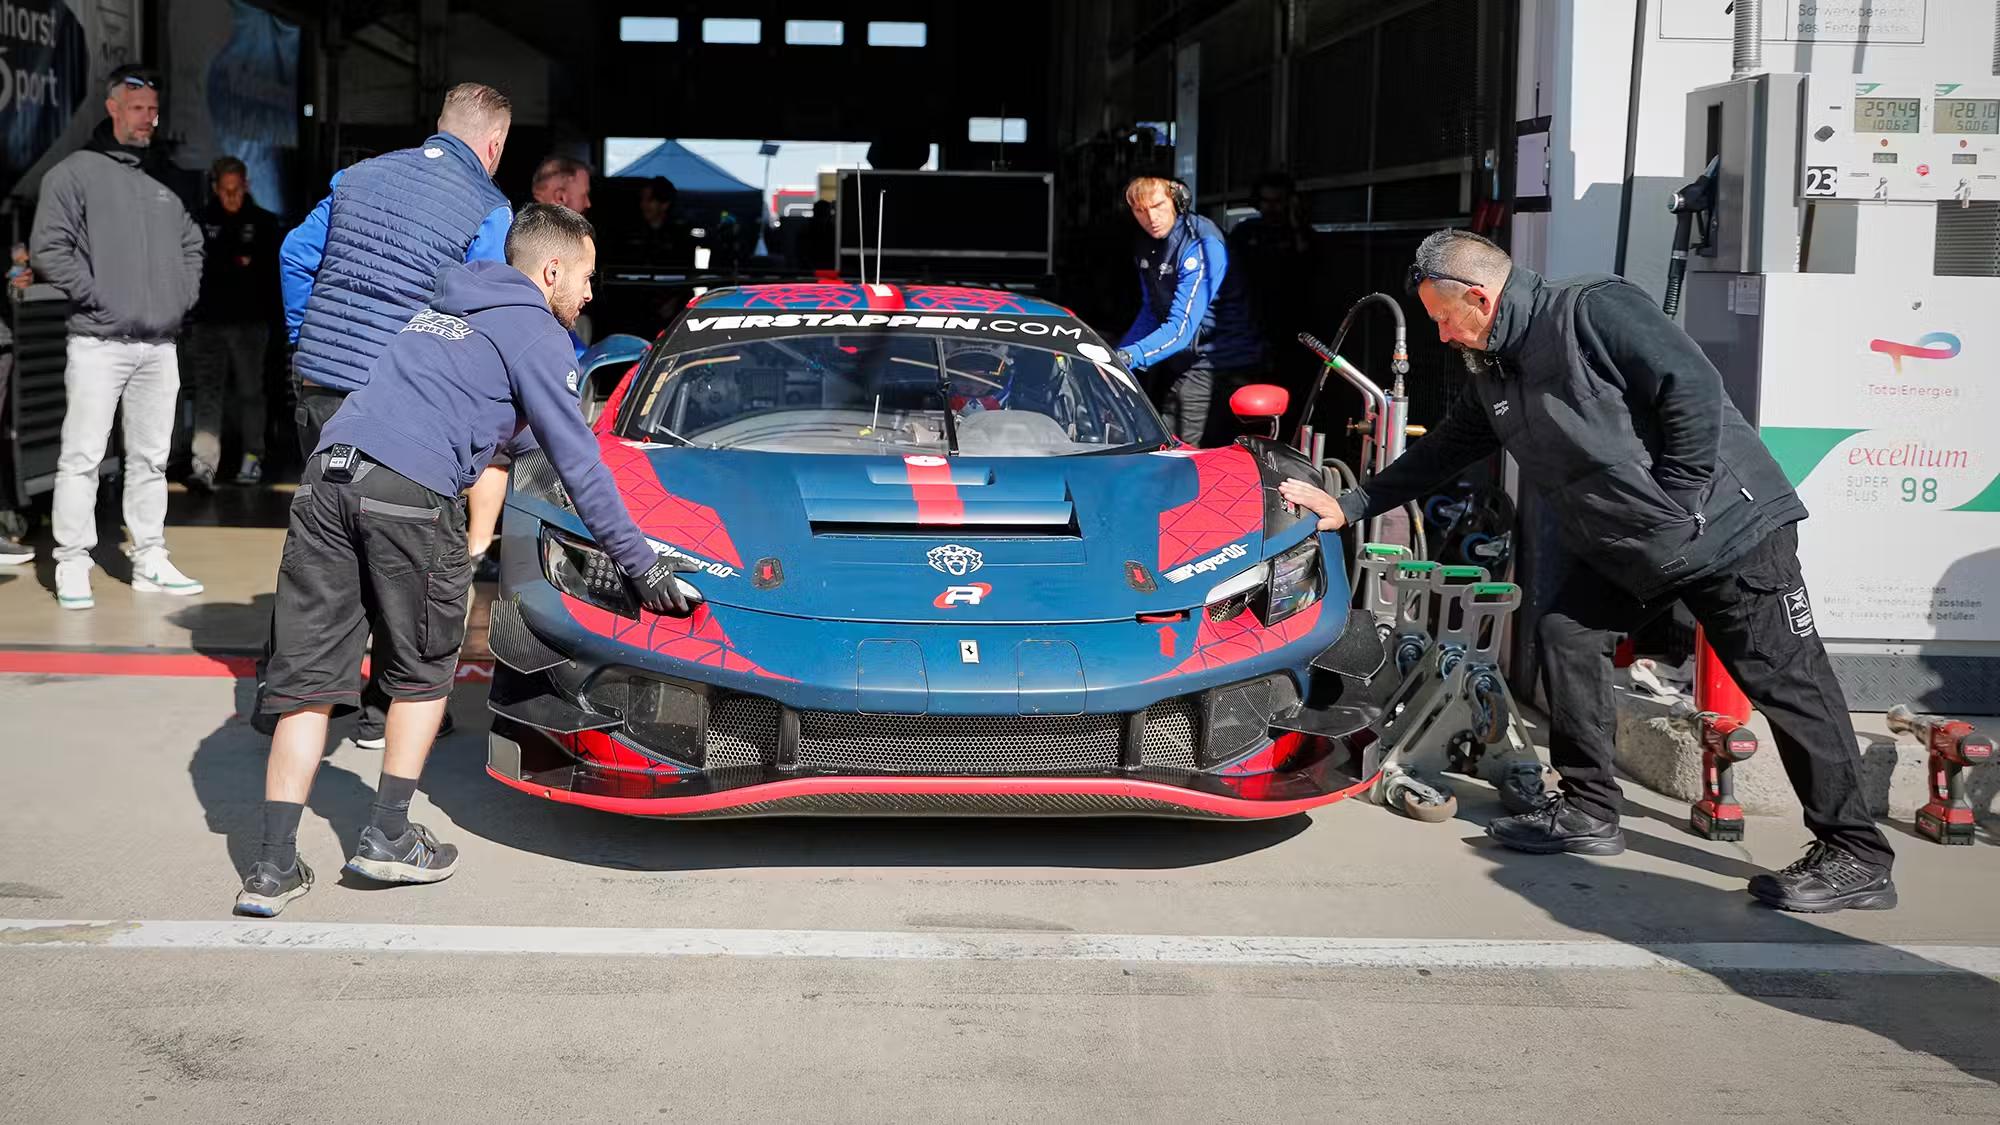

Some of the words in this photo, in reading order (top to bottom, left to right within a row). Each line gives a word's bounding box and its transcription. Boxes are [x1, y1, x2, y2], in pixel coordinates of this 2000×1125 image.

[0, 0, 57, 49] horst
[1807, 168, 1838, 196] 23
[686, 313, 1082, 340] VERSTAPPEN.COM
[1848, 444, 1969, 469] excellium
[1846, 475, 1889, 489] SUPER
[1846, 488, 1879, 502] PLUS
[1901, 477, 1938, 503] 98
